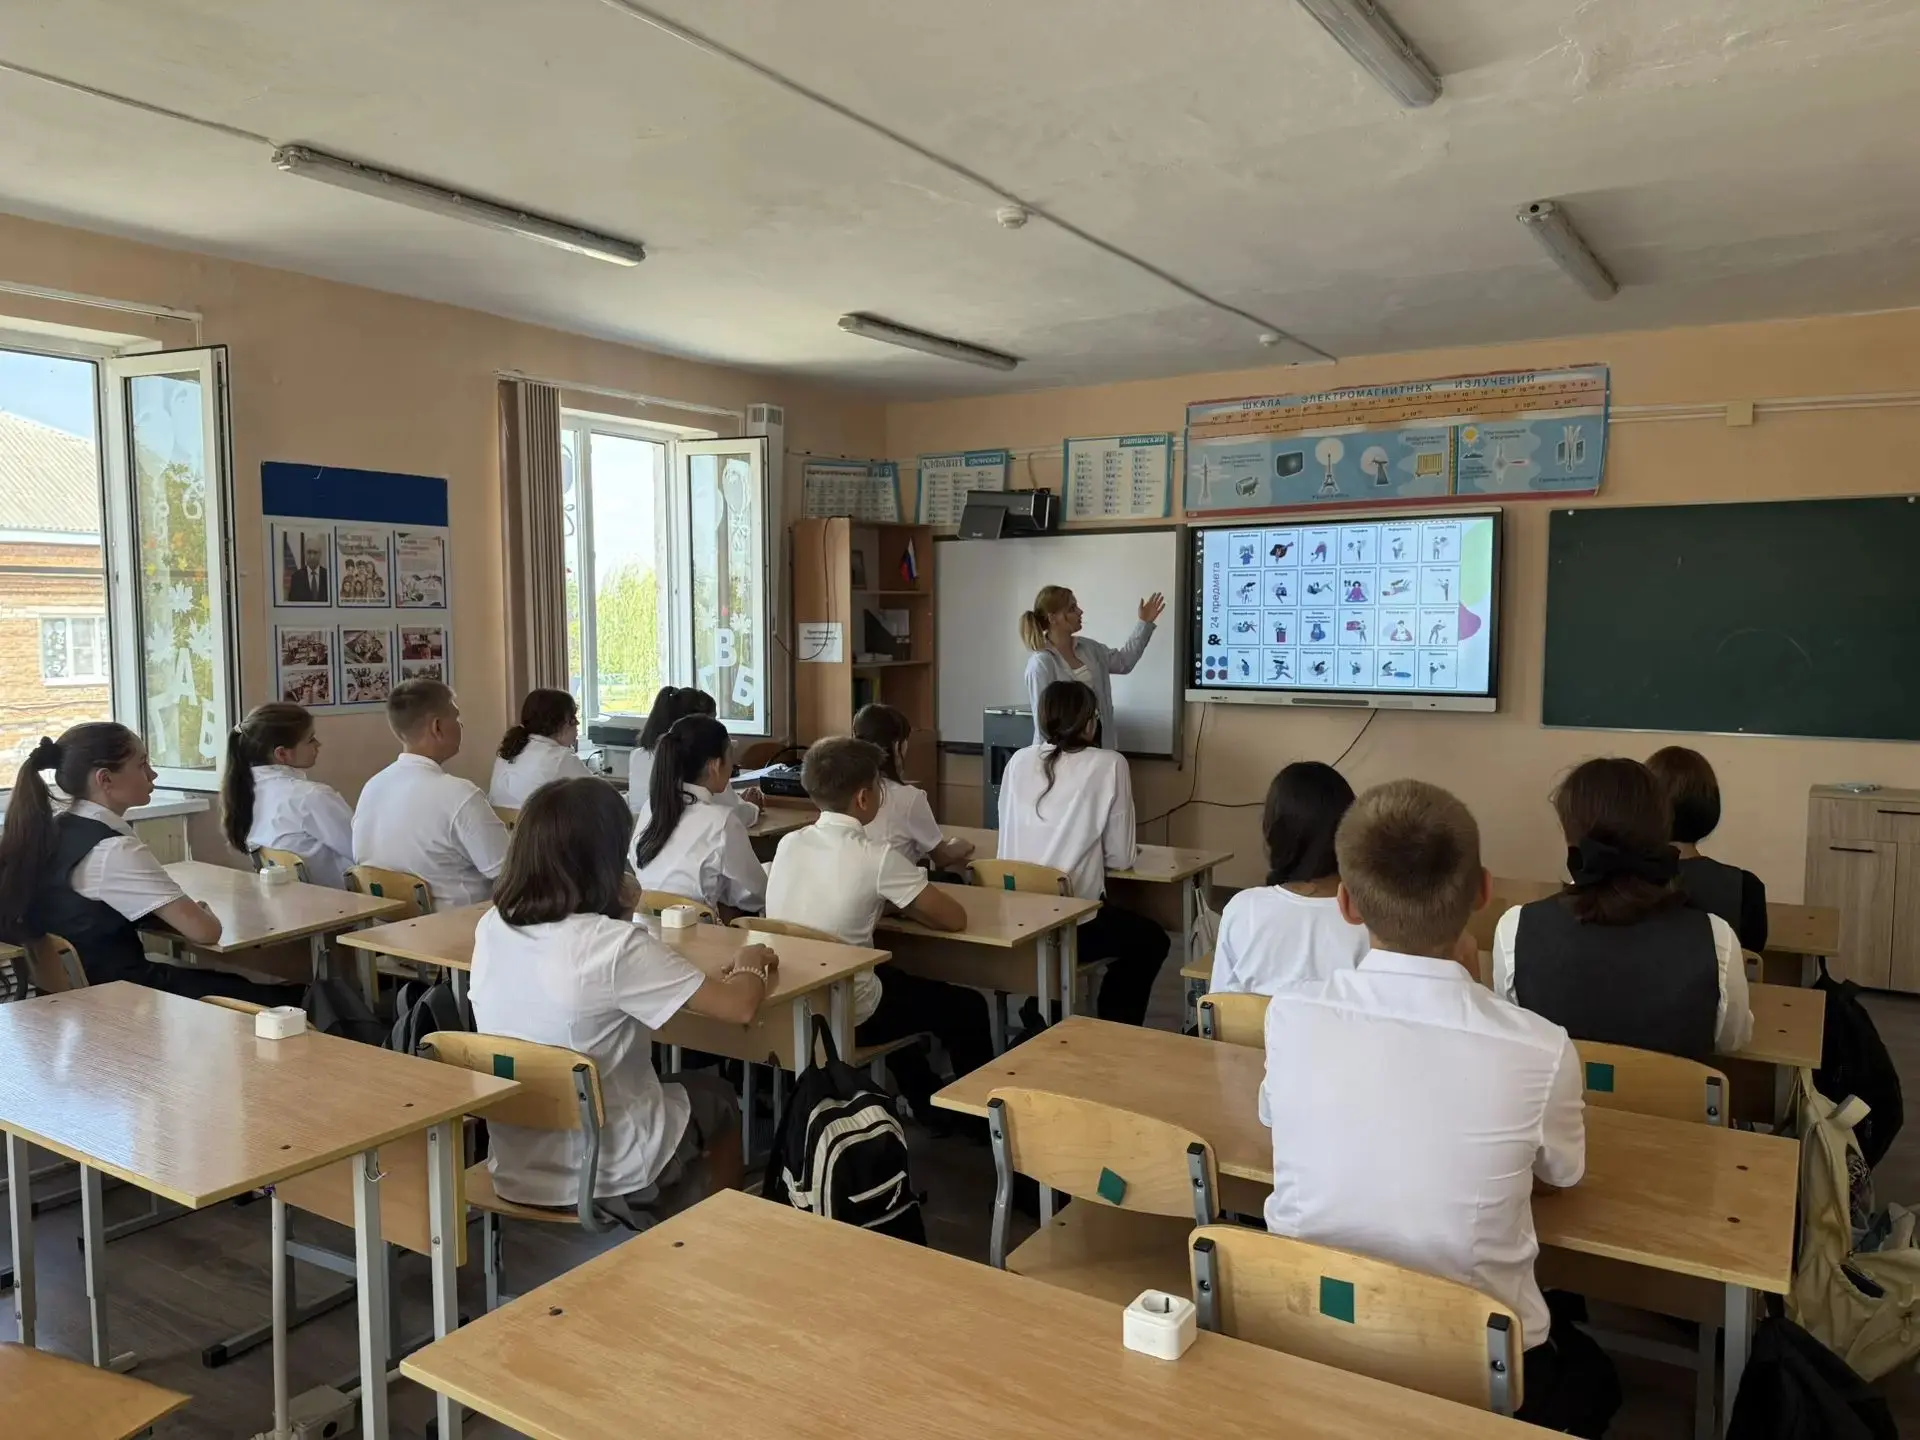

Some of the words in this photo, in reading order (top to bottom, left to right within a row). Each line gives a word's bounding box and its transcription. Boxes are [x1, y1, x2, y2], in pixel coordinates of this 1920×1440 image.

[1242, 399, 1281, 410] ШКАЛА
[1301, 384, 1432, 403] ЭЛЕКТРОМАГНИТНЫХ
[1455, 374, 1535, 389] ИЗЛУЧЕНИЙ
[1212, 561, 1221, 613] предмета
[1211, 616, 1219, 629] 24
